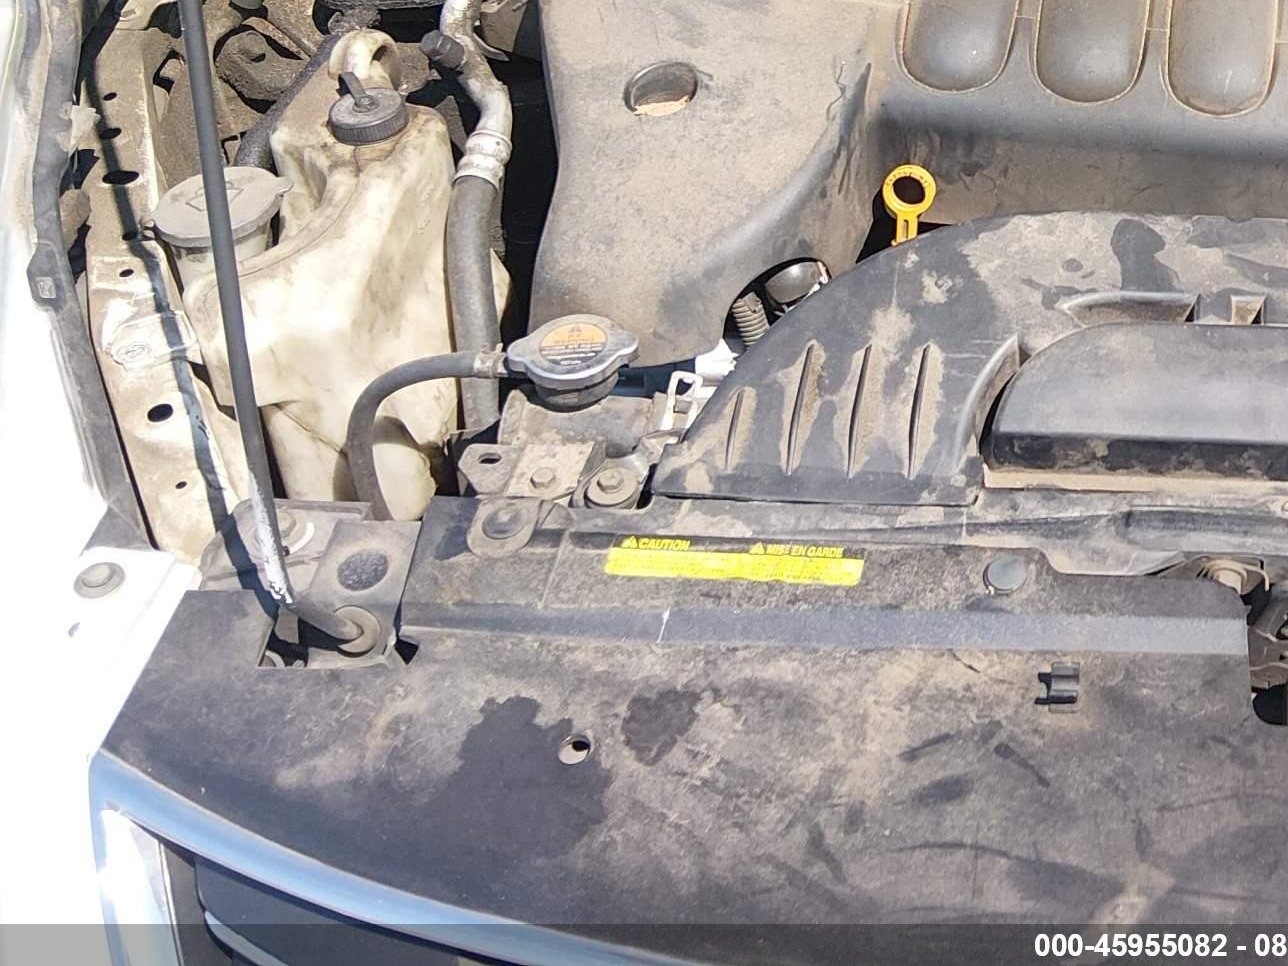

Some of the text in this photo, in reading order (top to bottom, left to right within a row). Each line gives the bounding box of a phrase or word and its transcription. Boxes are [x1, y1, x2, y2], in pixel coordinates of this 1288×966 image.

[639, 538, 691, 551] CAUTION
[790, 545, 807, 556] EN
[807, 546, 845, 558] GARDE
